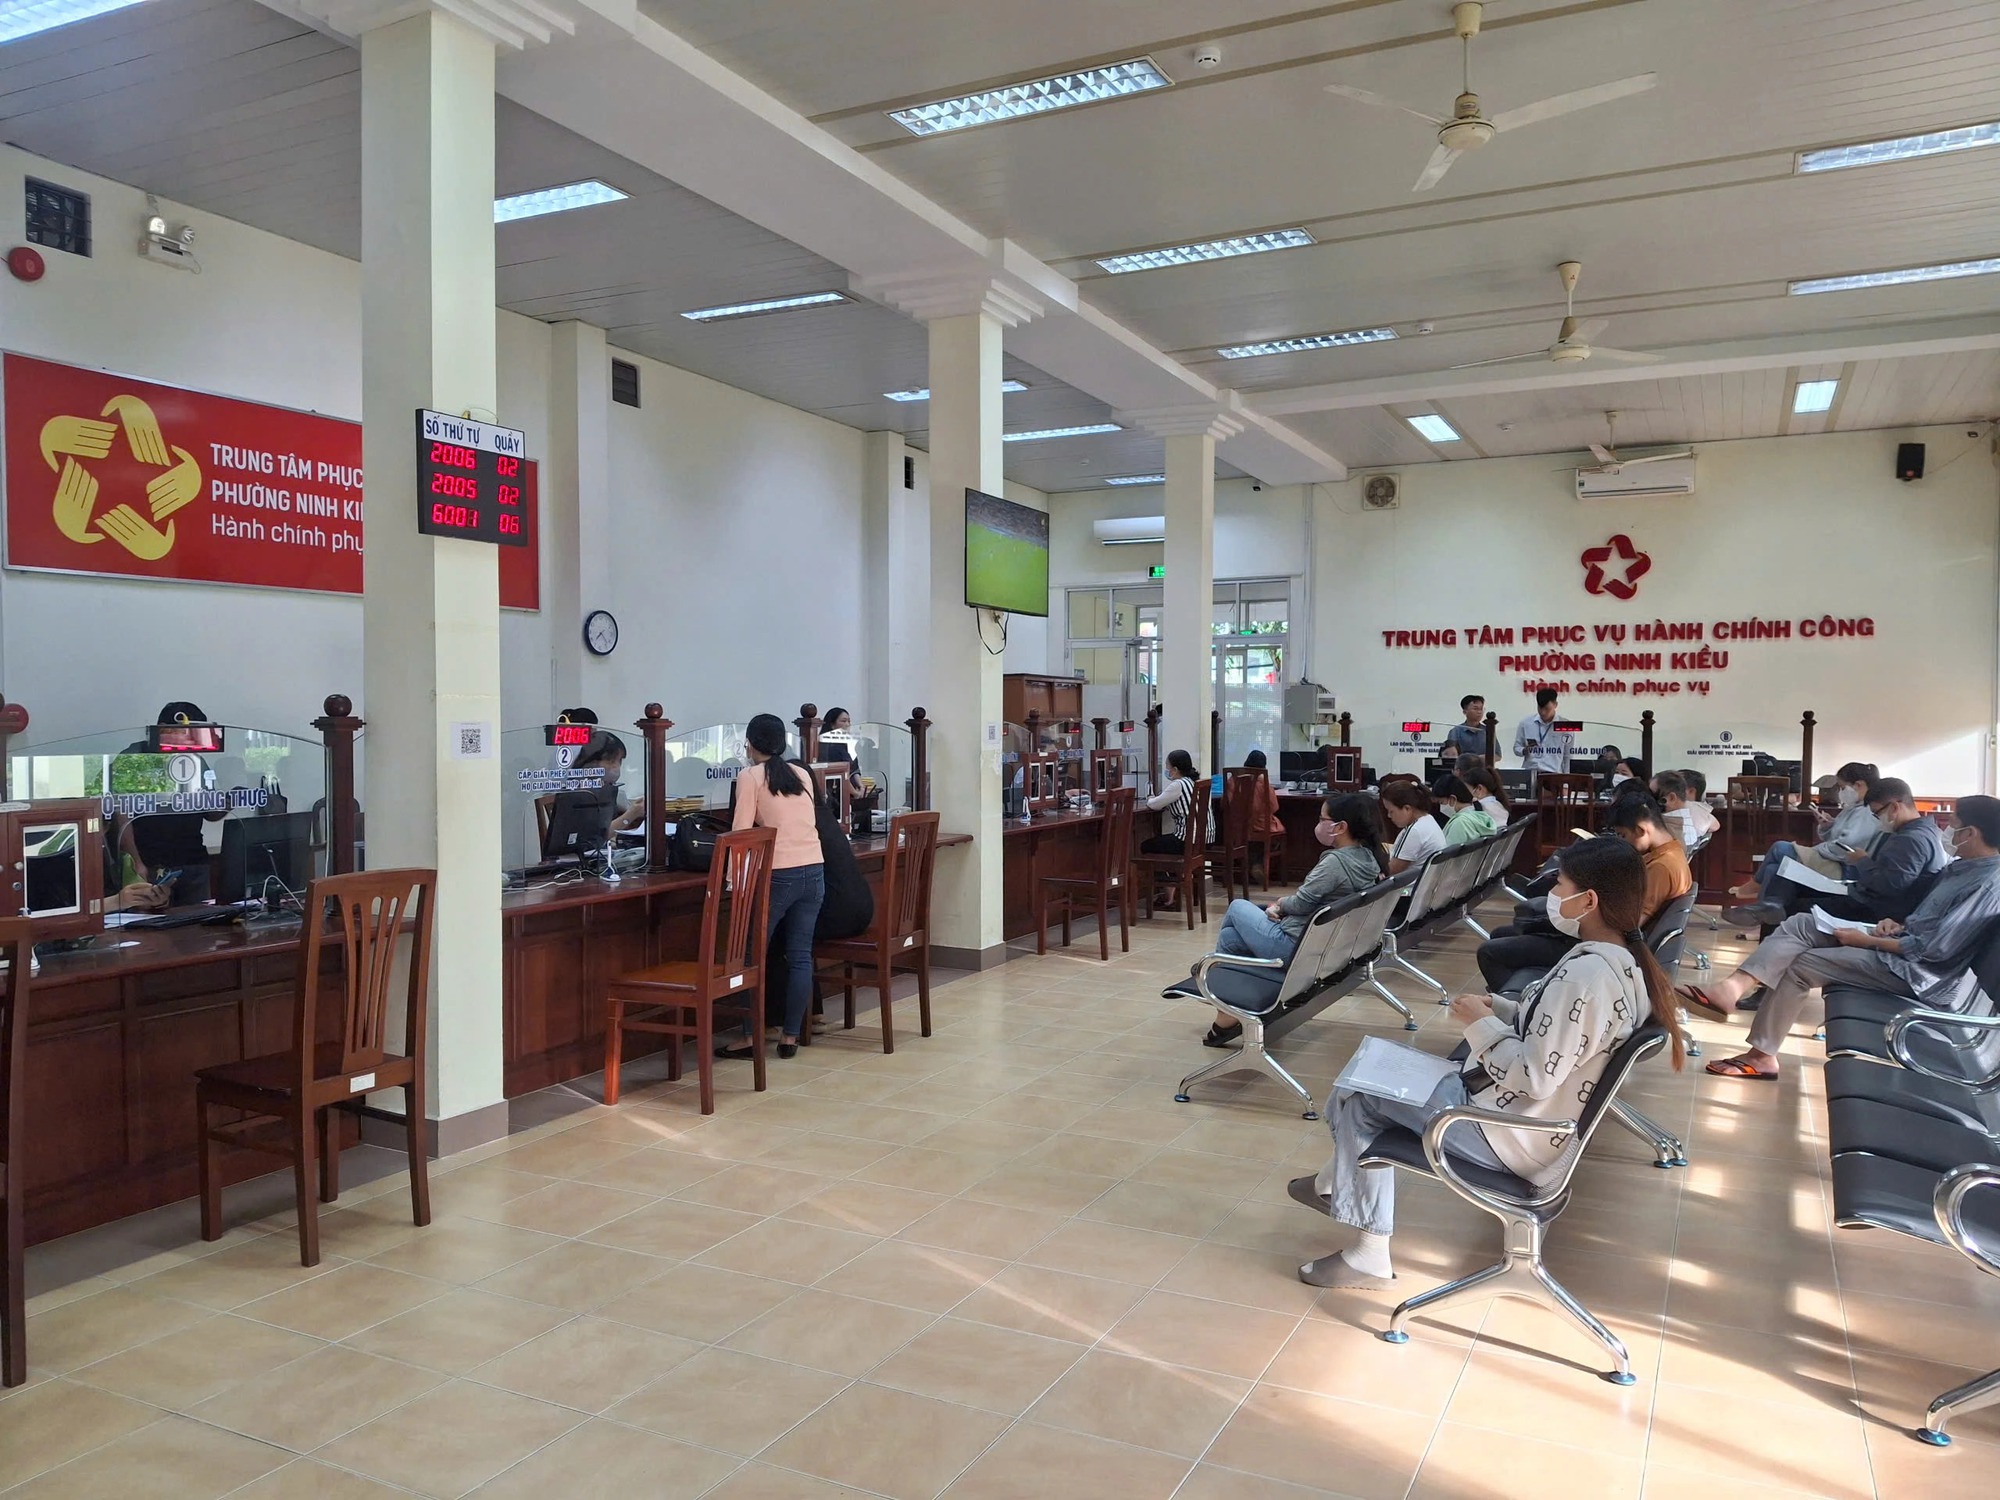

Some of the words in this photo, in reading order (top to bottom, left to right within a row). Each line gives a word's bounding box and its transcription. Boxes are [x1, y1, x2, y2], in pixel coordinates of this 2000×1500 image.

[426, 415, 440, 436] SỐ
[443, 422, 464, 440] THỨ
[466, 427, 480, 447] TỰ
[494, 431, 520, 453] QUẦY
[210, 443, 274, 474] TRUNG
[278, 452, 312, 480] TÂM
[318, 462, 363, 491] PHỤC
[430, 442, 476, 470] 2006
[497, 456, 518, 478] 02
[212, 480, 290, 512] PHƯỜNG
[296, 492, 338, 518] NINH
[344, 500, 363, 522] KI
[431, 472, 478, 500] 2005
[498, 484, 519, 506] 02
[432, 504, 478, 528] 6001
[499, 514, 520, 534] 06
[212, 514, 264, 540] Hành
[271, 522, 326, 547] chính
[332, 530, 363, 556] phụ
[1382, 629, 1457, 647] TRUNG
[1464, 624, 1514, 646] TÂM
[1522, 625, 1586, 647] PHỤC
[1594, 624, 1626, 646] VỤ
[1634, 618, 1704, 641] HÀNH
[1712, 617, 1791, 640] CHÍNH
[1800, 614, 1874, 638] CÔNG
[1499, 648, 1596, 672] PHƯỜNG
[1604, 652, 1661, 671] NINH
[1671, 644, 1729, 670] KIỀU
[1523, 678, 1570, 693] Hành
[1576, 678, 1626, 693] chính
[1633, 679, 1680, 696] phục
[1687, 680, 1710, 696] vụ
[554, 727, 590, 744] 2006
[178, 759, 186, 778] 1
[561, 749, 568, 763] 2
[706, 765, 732, 780] CÔNG
[119, 794, 156, 818] TỊCH
[172, 788, 226, 812] CHỨNG
[229, 788, 268, 812] THỰC
